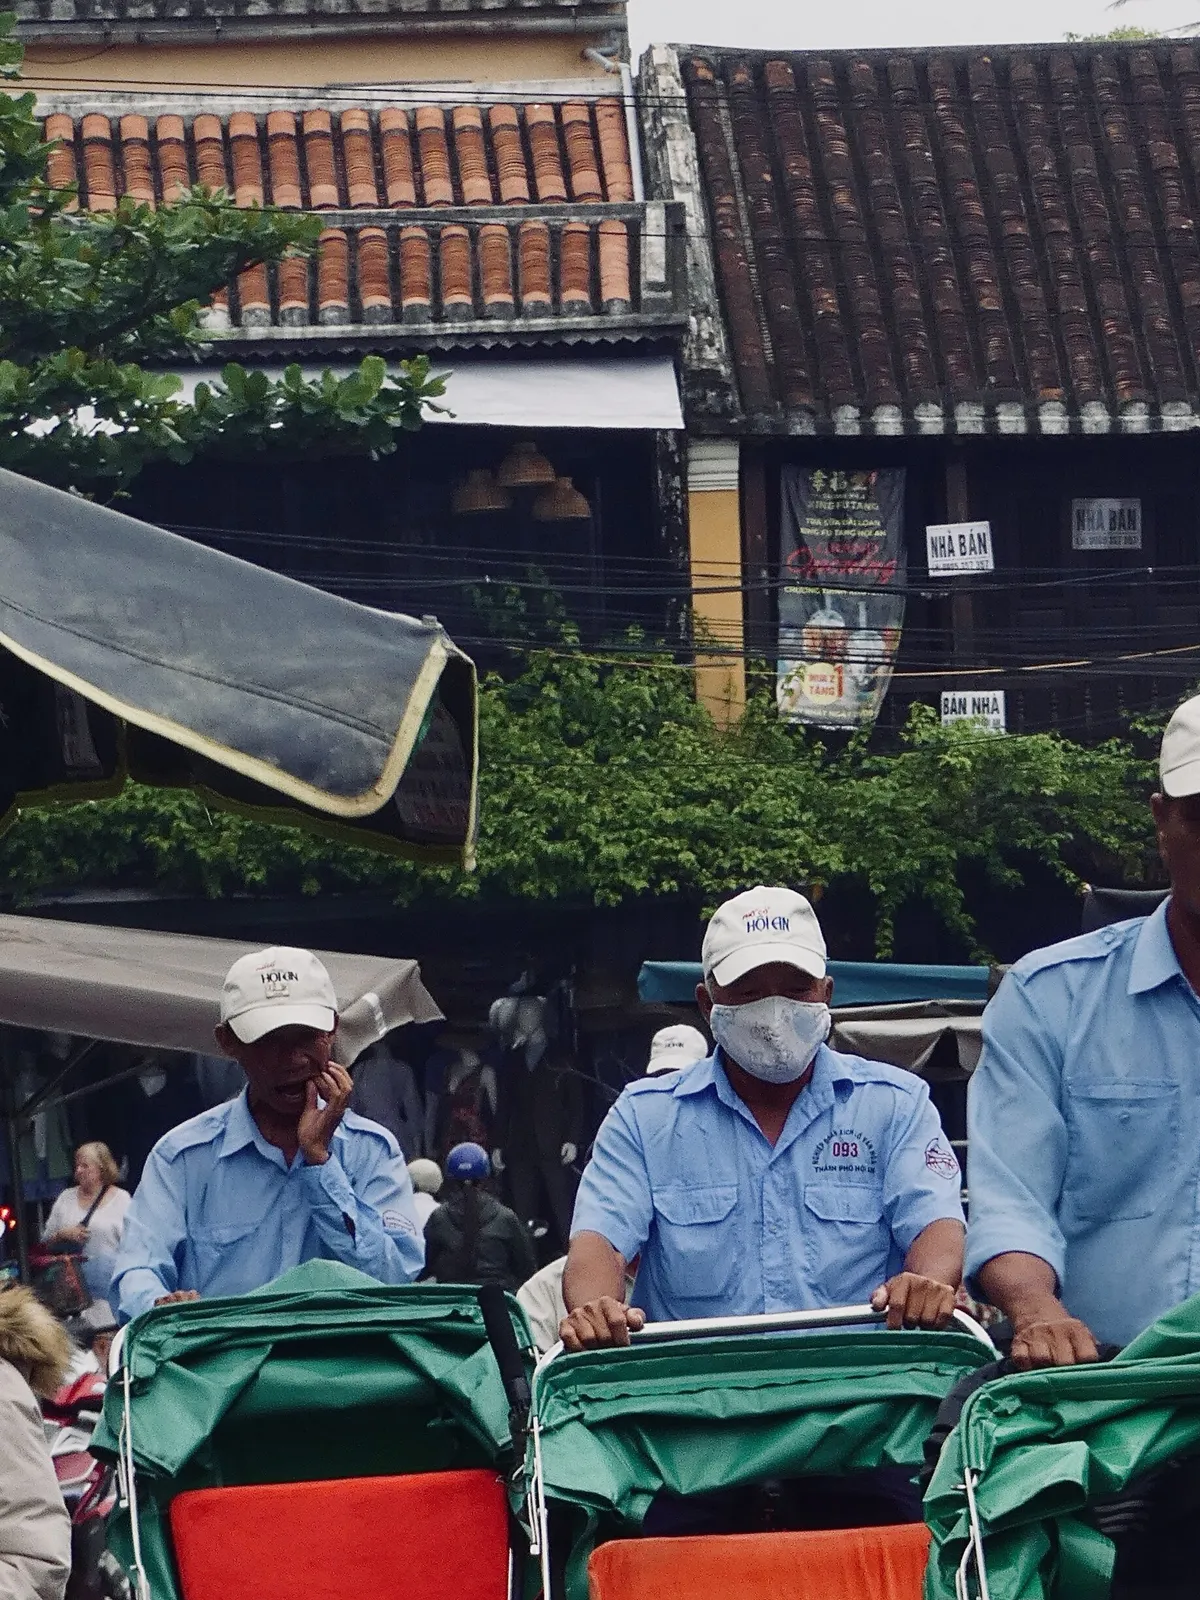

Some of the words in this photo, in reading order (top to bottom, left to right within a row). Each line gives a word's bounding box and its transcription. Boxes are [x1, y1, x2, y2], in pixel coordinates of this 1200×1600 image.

[930, 530, 955, 558] NHÀ
[958, 529, 987, 557] BÁN
[943, 693, 967, 715] BÁN
[972, 693, 1000, 715] NHÀ
[833, 1142, 858, 1157] 093
